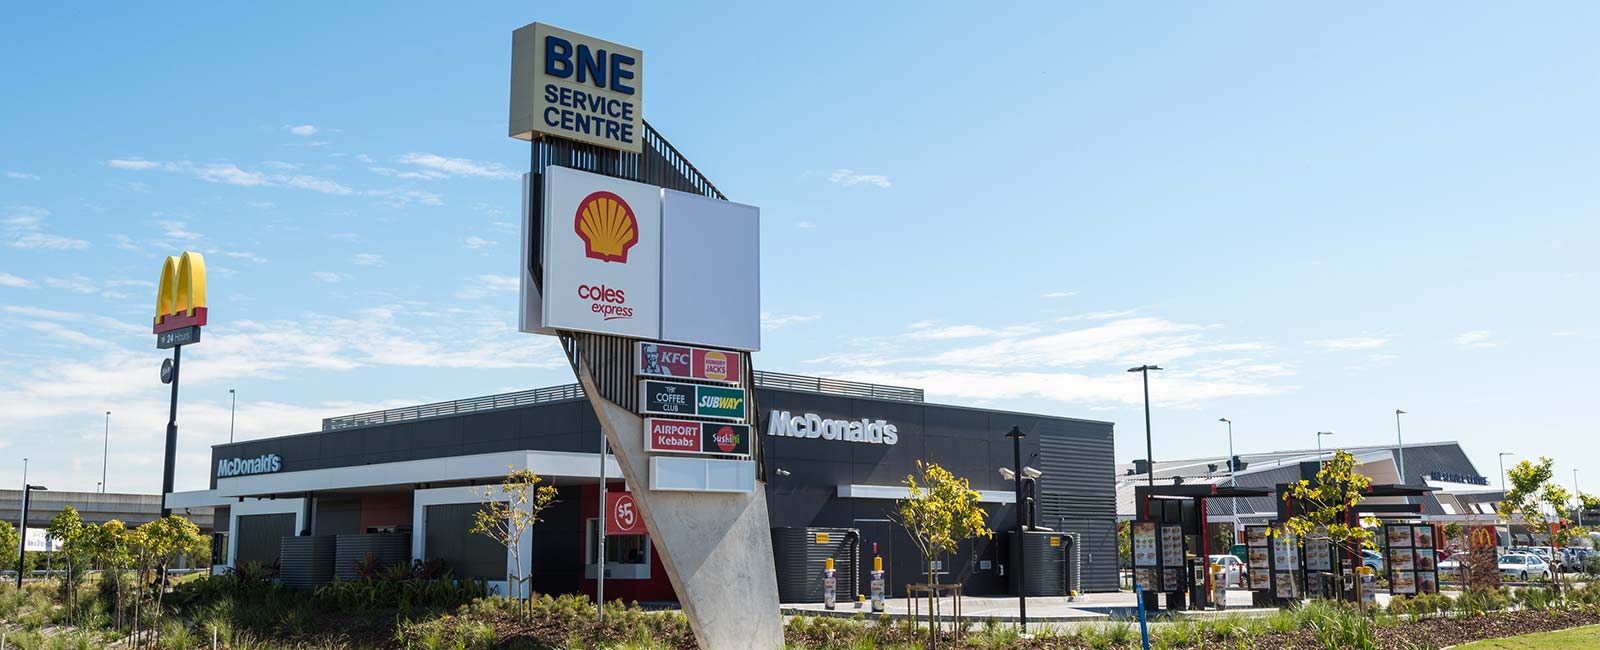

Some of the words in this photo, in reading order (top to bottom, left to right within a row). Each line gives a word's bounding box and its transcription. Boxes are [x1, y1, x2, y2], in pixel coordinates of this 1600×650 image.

[545, 35, 635, 95] BNE
[544, 84, 634, 122] SERVICE
[543, 106, 634, 144] CENTRE
[578, 284, 625, 304] coles
[591, 303, 633, 317] express
[166, 334, 174, 343] 24
[174, 332, 190, 342] Hours
[662, 352, 689, 365] KFC
[656, 393, 685, 403] COFFEE
[699, 396, 742, 409] SUBWAY
[662, 404, 679, 412] CLUB
[654, 425, 697, 436] AIRPORT
[767, 410, 898, 445] McDonald's
[658, 436, 694, 447] Kebabs
[217, 453, 281, 477] McDonald's
[618, 502, 634, 525] $5
